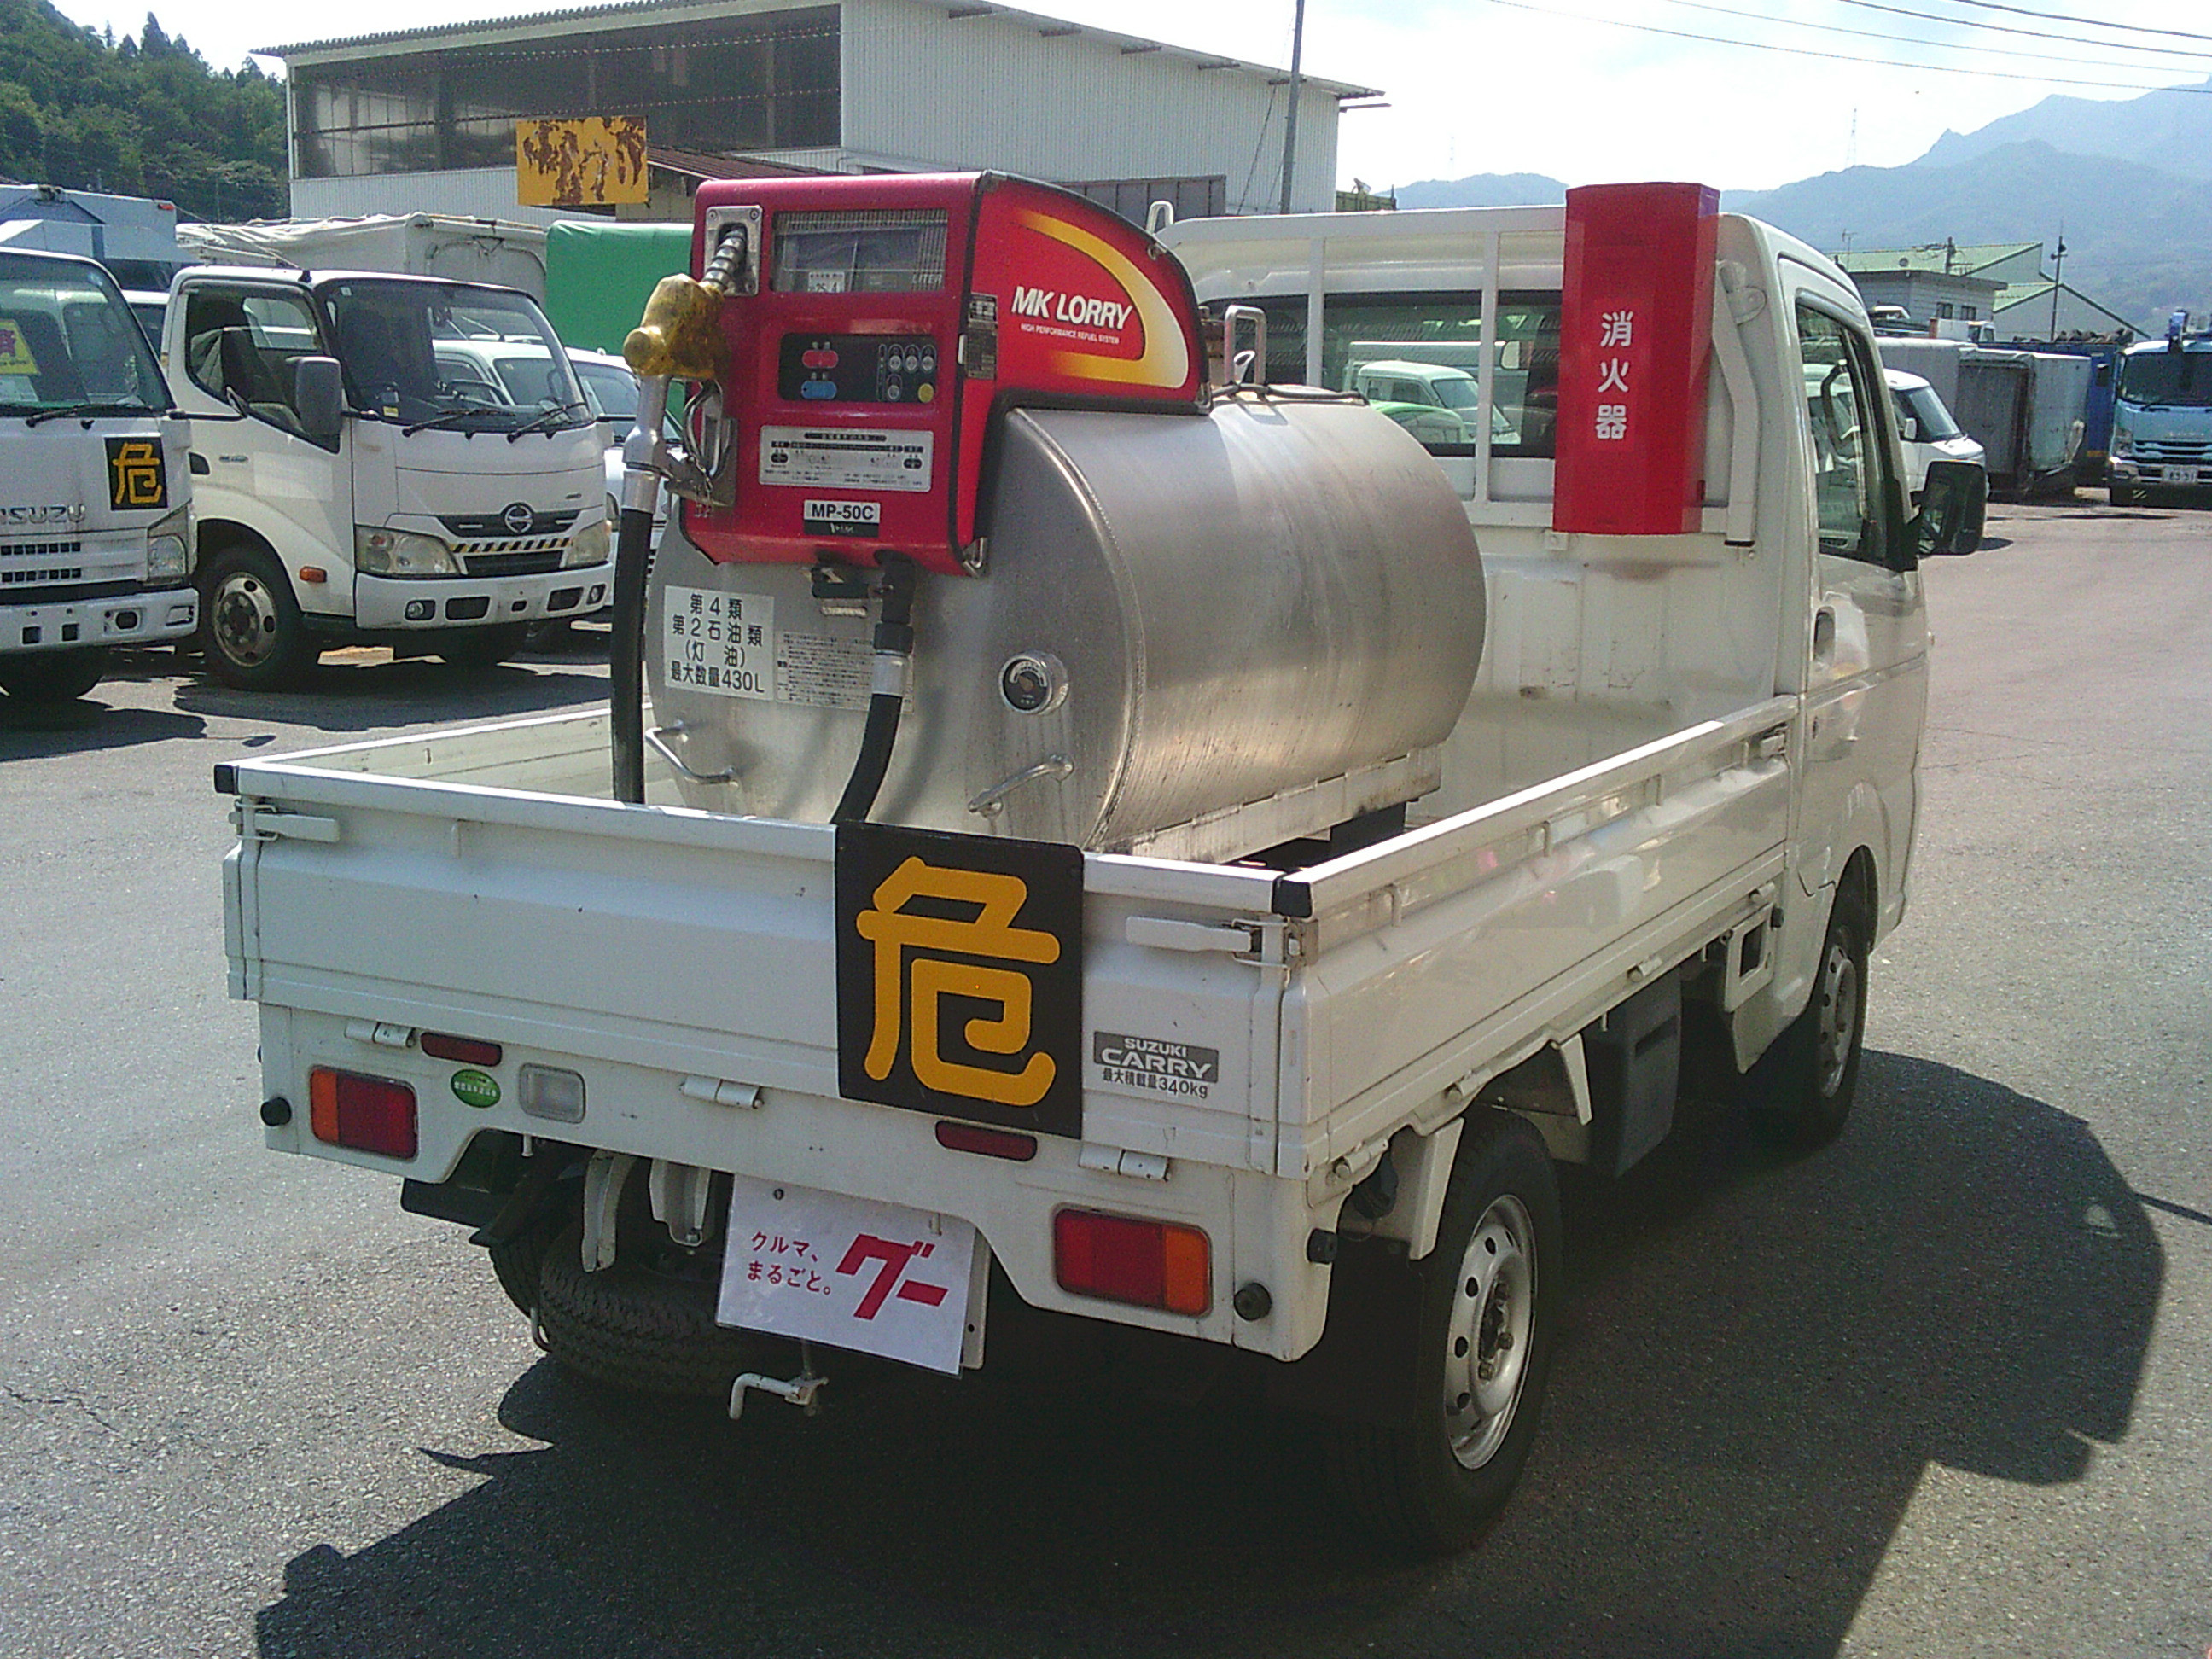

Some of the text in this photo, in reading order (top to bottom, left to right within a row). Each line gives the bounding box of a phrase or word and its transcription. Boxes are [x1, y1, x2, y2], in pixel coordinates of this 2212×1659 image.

[912, 273, 942, 285] LITER
[1010, 286, 1055, 318] MK
[1057, 294, 1133, 330] LORRY
[1595, 310, 1633, 439] 消火器
[113, 442, 162, 504] 危
[812, 504, 874, 520] MP-50C
[855, 855, 1062, 1107] 危
[1101, 1047, 1212, 1079] CARRY
[1124, 1038, 1188, 1058] SUZUKI
[751, 1231, 818, 1262] クルマ、
[747, 1260, 831, 1295] まるごと。
[835, 1233, 949, 1320] グー
